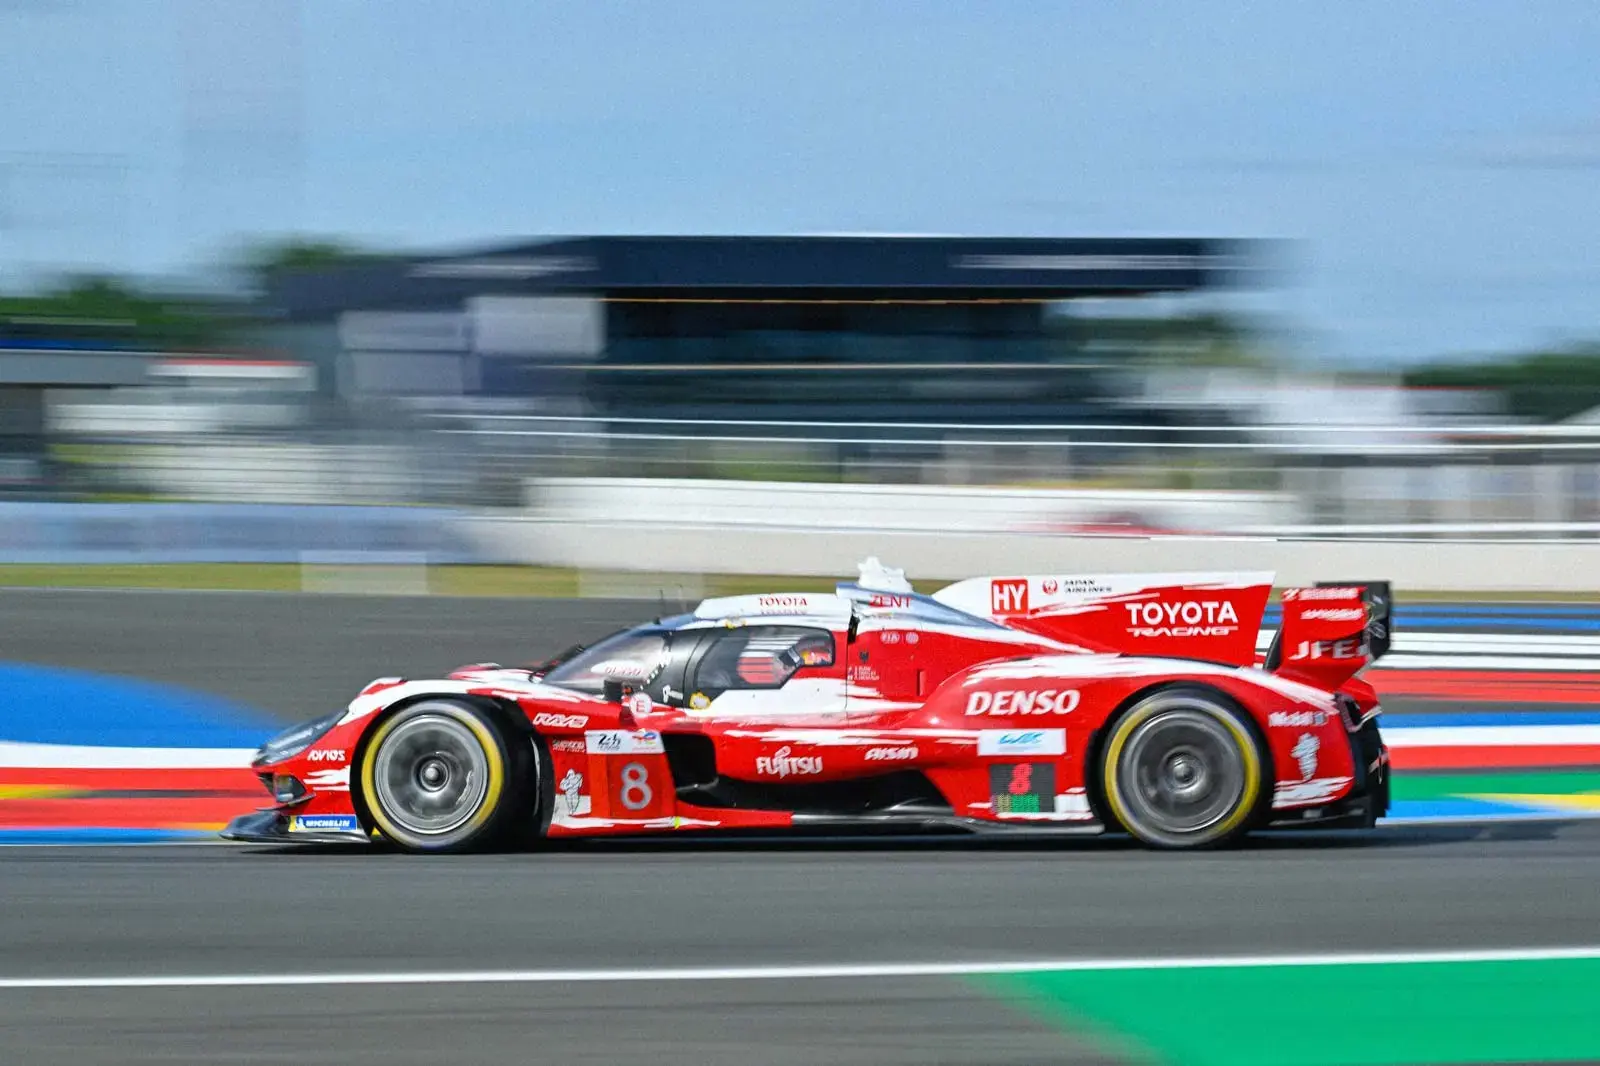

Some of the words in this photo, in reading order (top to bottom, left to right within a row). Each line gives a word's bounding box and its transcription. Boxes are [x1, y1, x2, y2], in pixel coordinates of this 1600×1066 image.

[759, 597, 807, 606] TOYOTA
[869, 594, 911, 608] ZENT
[993, 583, 1026, 611] HY
[1125, 601, 1238, 625] TOYOTA
[1126, 626, 1238, 637] RACING
[636, 701, 644, 712] E
[965, 690, 1080, 715] DENSO
[755, 746, 823, 779] FUJITSU
[621, 761, 653, 811] 8
[1007, 763, 1034, 795] 8
[305, 819, 351, 828] MICHELIN
